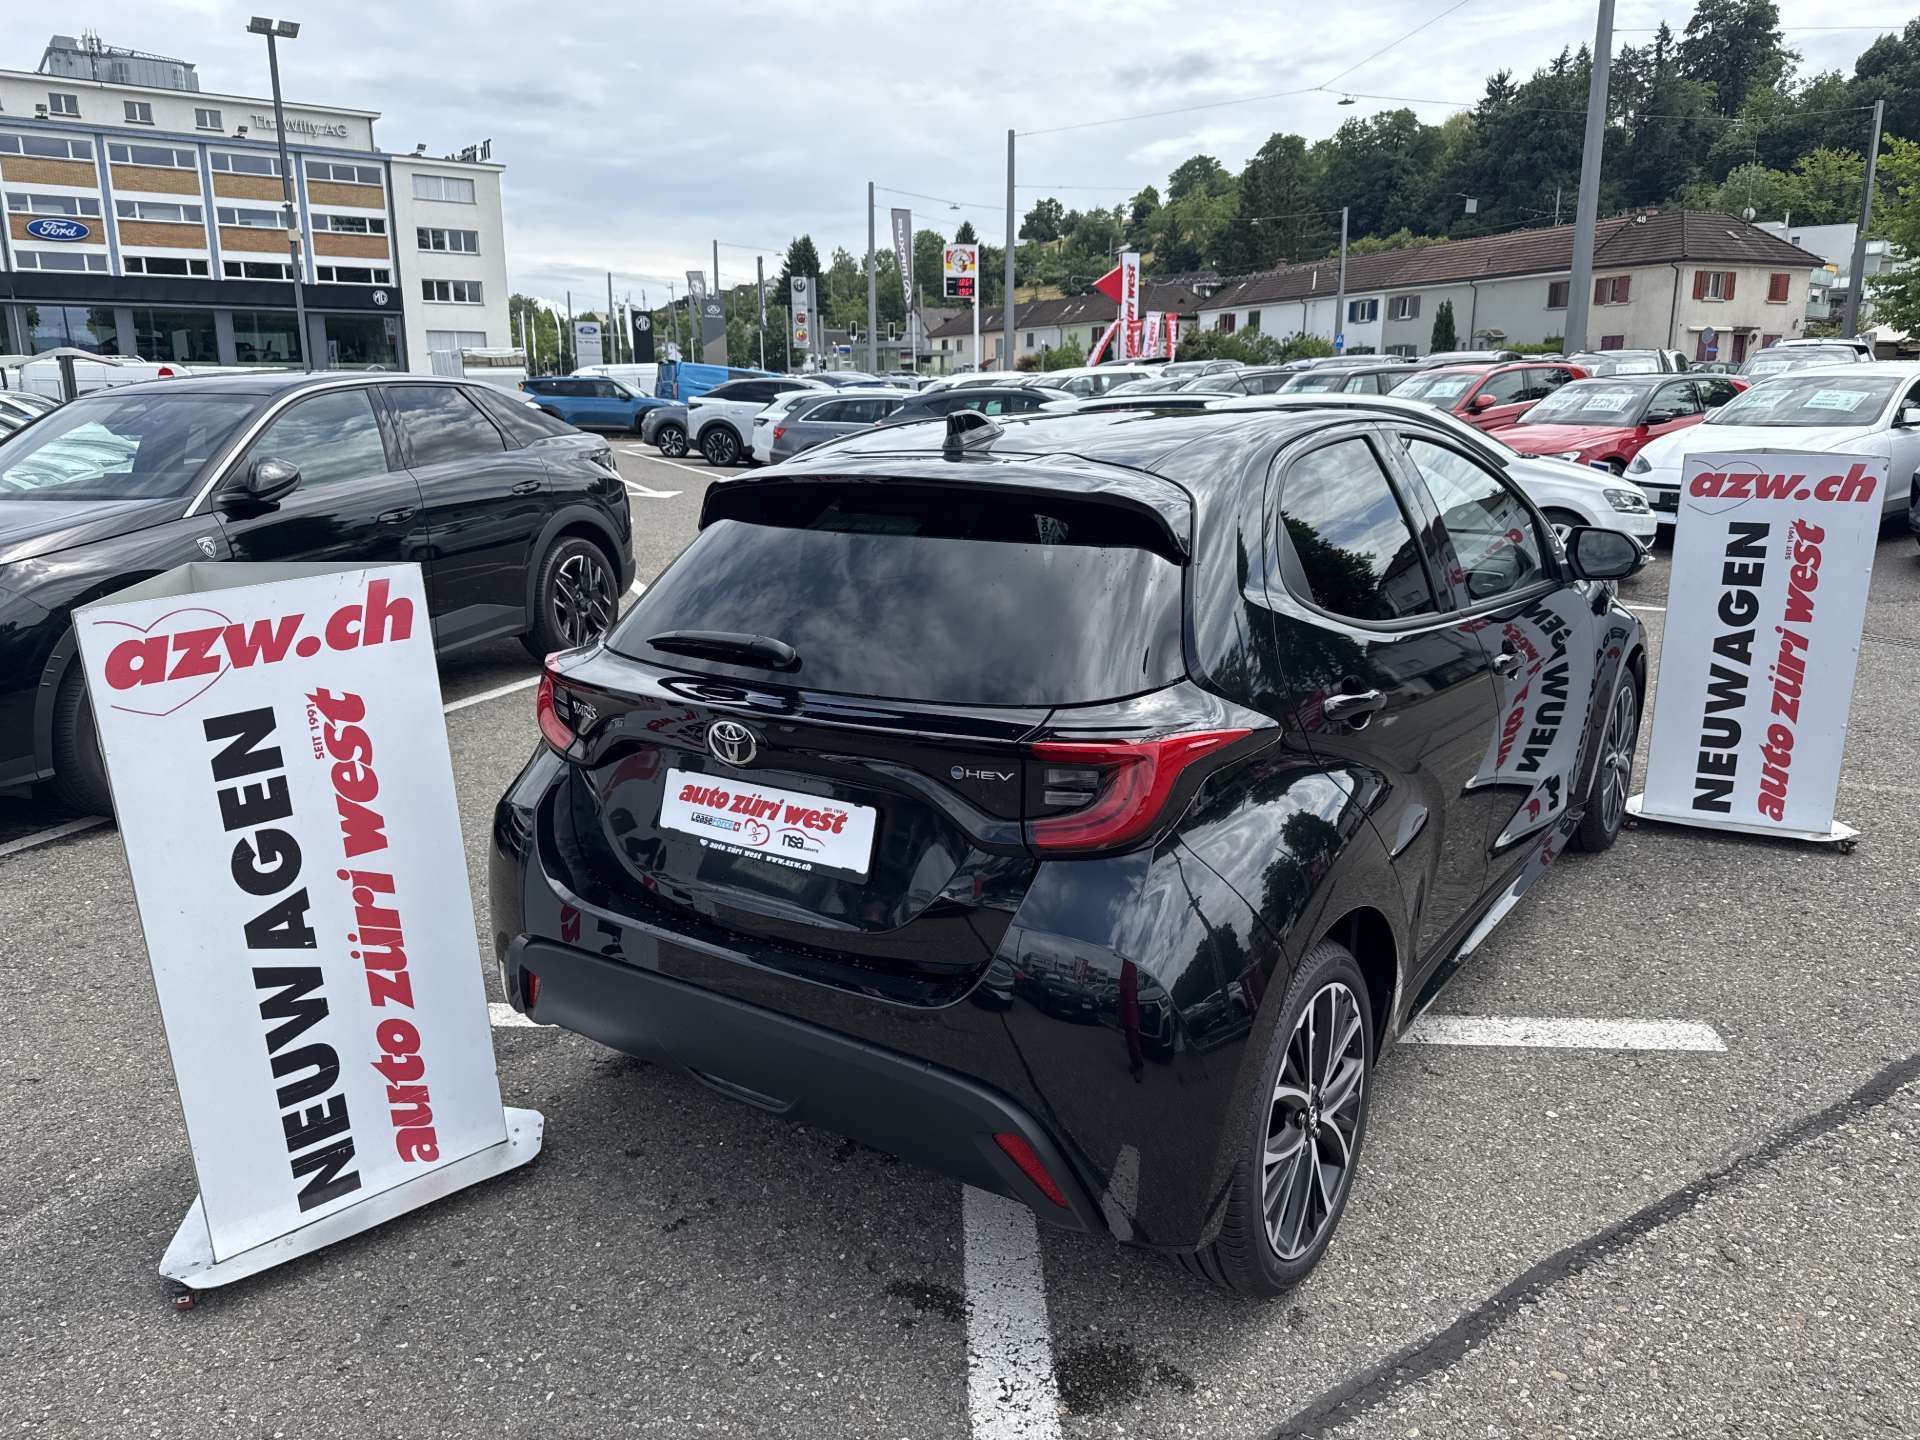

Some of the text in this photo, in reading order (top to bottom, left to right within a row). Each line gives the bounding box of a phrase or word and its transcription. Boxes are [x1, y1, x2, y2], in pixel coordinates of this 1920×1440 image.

[324, 124, 349, 137] AG
[40, 220, 77, 237] Ford
[1689, 464, 1878, 503] azw.ch
[1784, 546, 1793, 560] SEIT
[104, 578, 414, 691] azw.ch
[1692, 521, 1771, 814] NEUWAGEN
[1757, 518, 1825, 822] auto züri west
[306, 704, 325, 760] SEIT 1991
[965, 769, 1015, 781] HEV
[679, 784, 848, 835] auto züri west
[744, 850, 762, 860] west
[782, 834, 804, 849] nsa
[303, 687, 440, 1163] auto züri west
[202, 706, 363, 1214] NEUWAGEN
